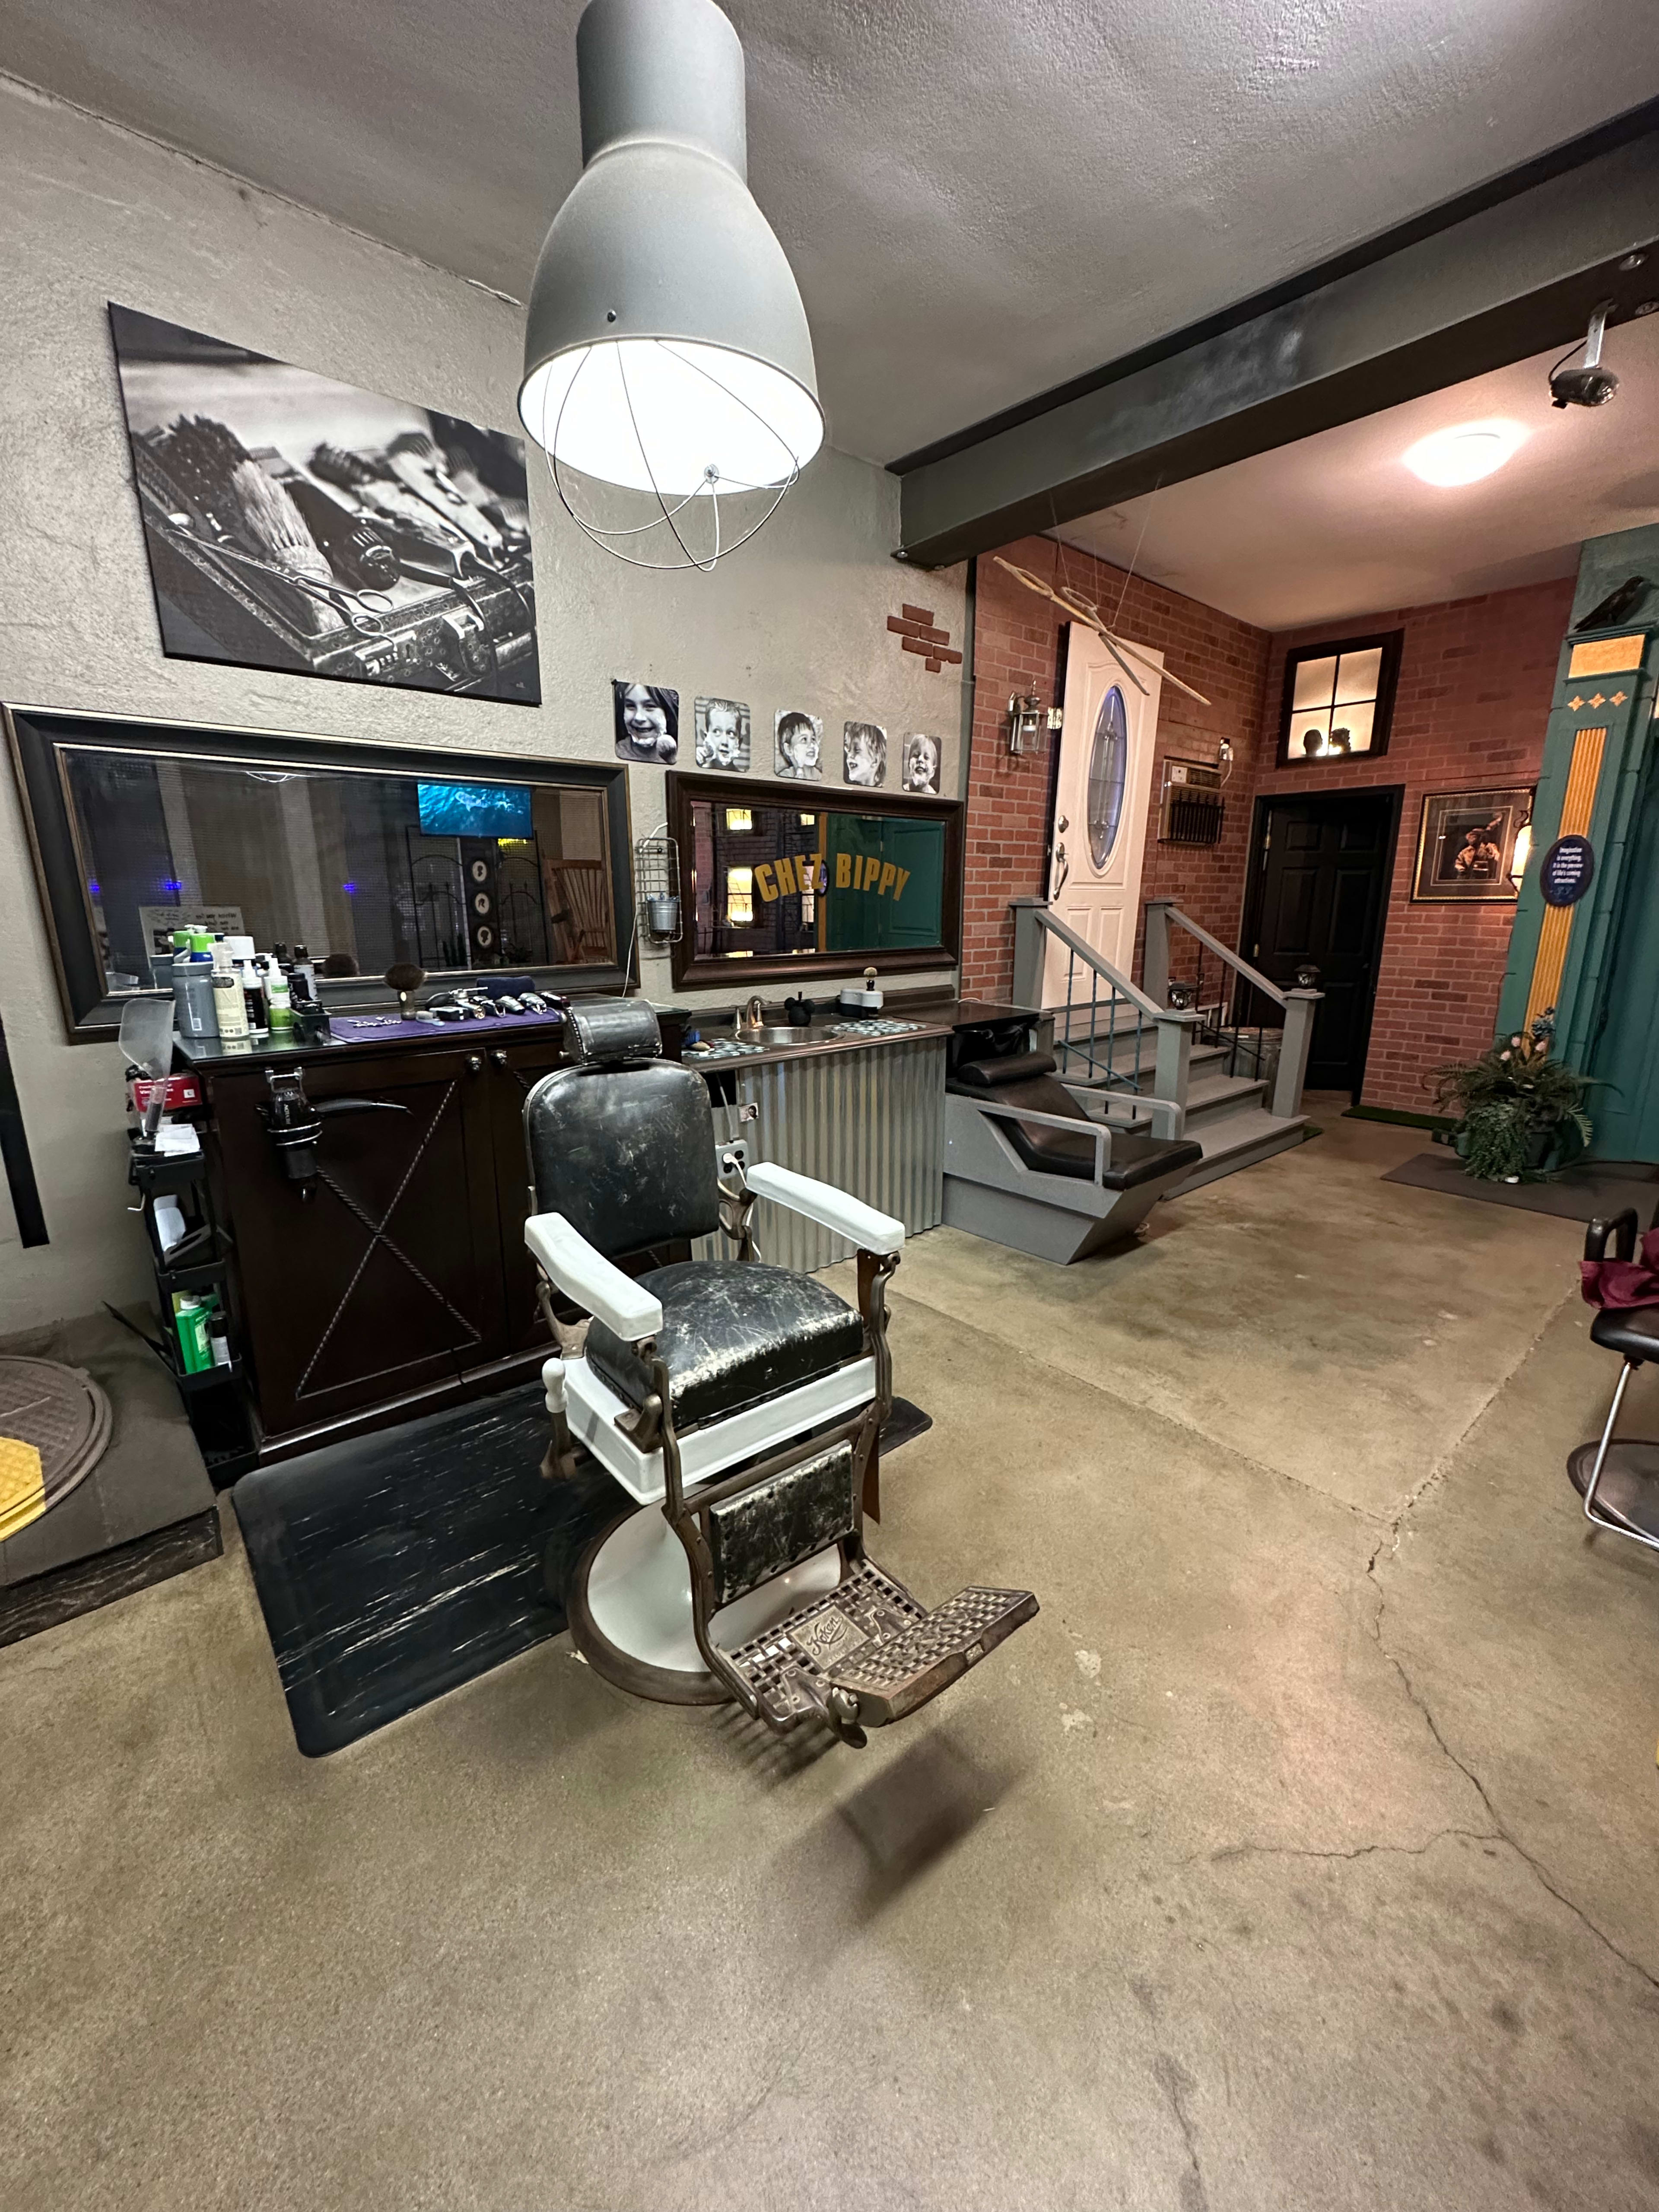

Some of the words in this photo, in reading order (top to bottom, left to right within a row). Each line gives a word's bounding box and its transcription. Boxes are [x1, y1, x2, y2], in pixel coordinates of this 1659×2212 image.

[754, 854, 824, 902] CHEZ
[836, 853, 911, 901] BIPPY
[806, 1616, 848, 1656] Koken
